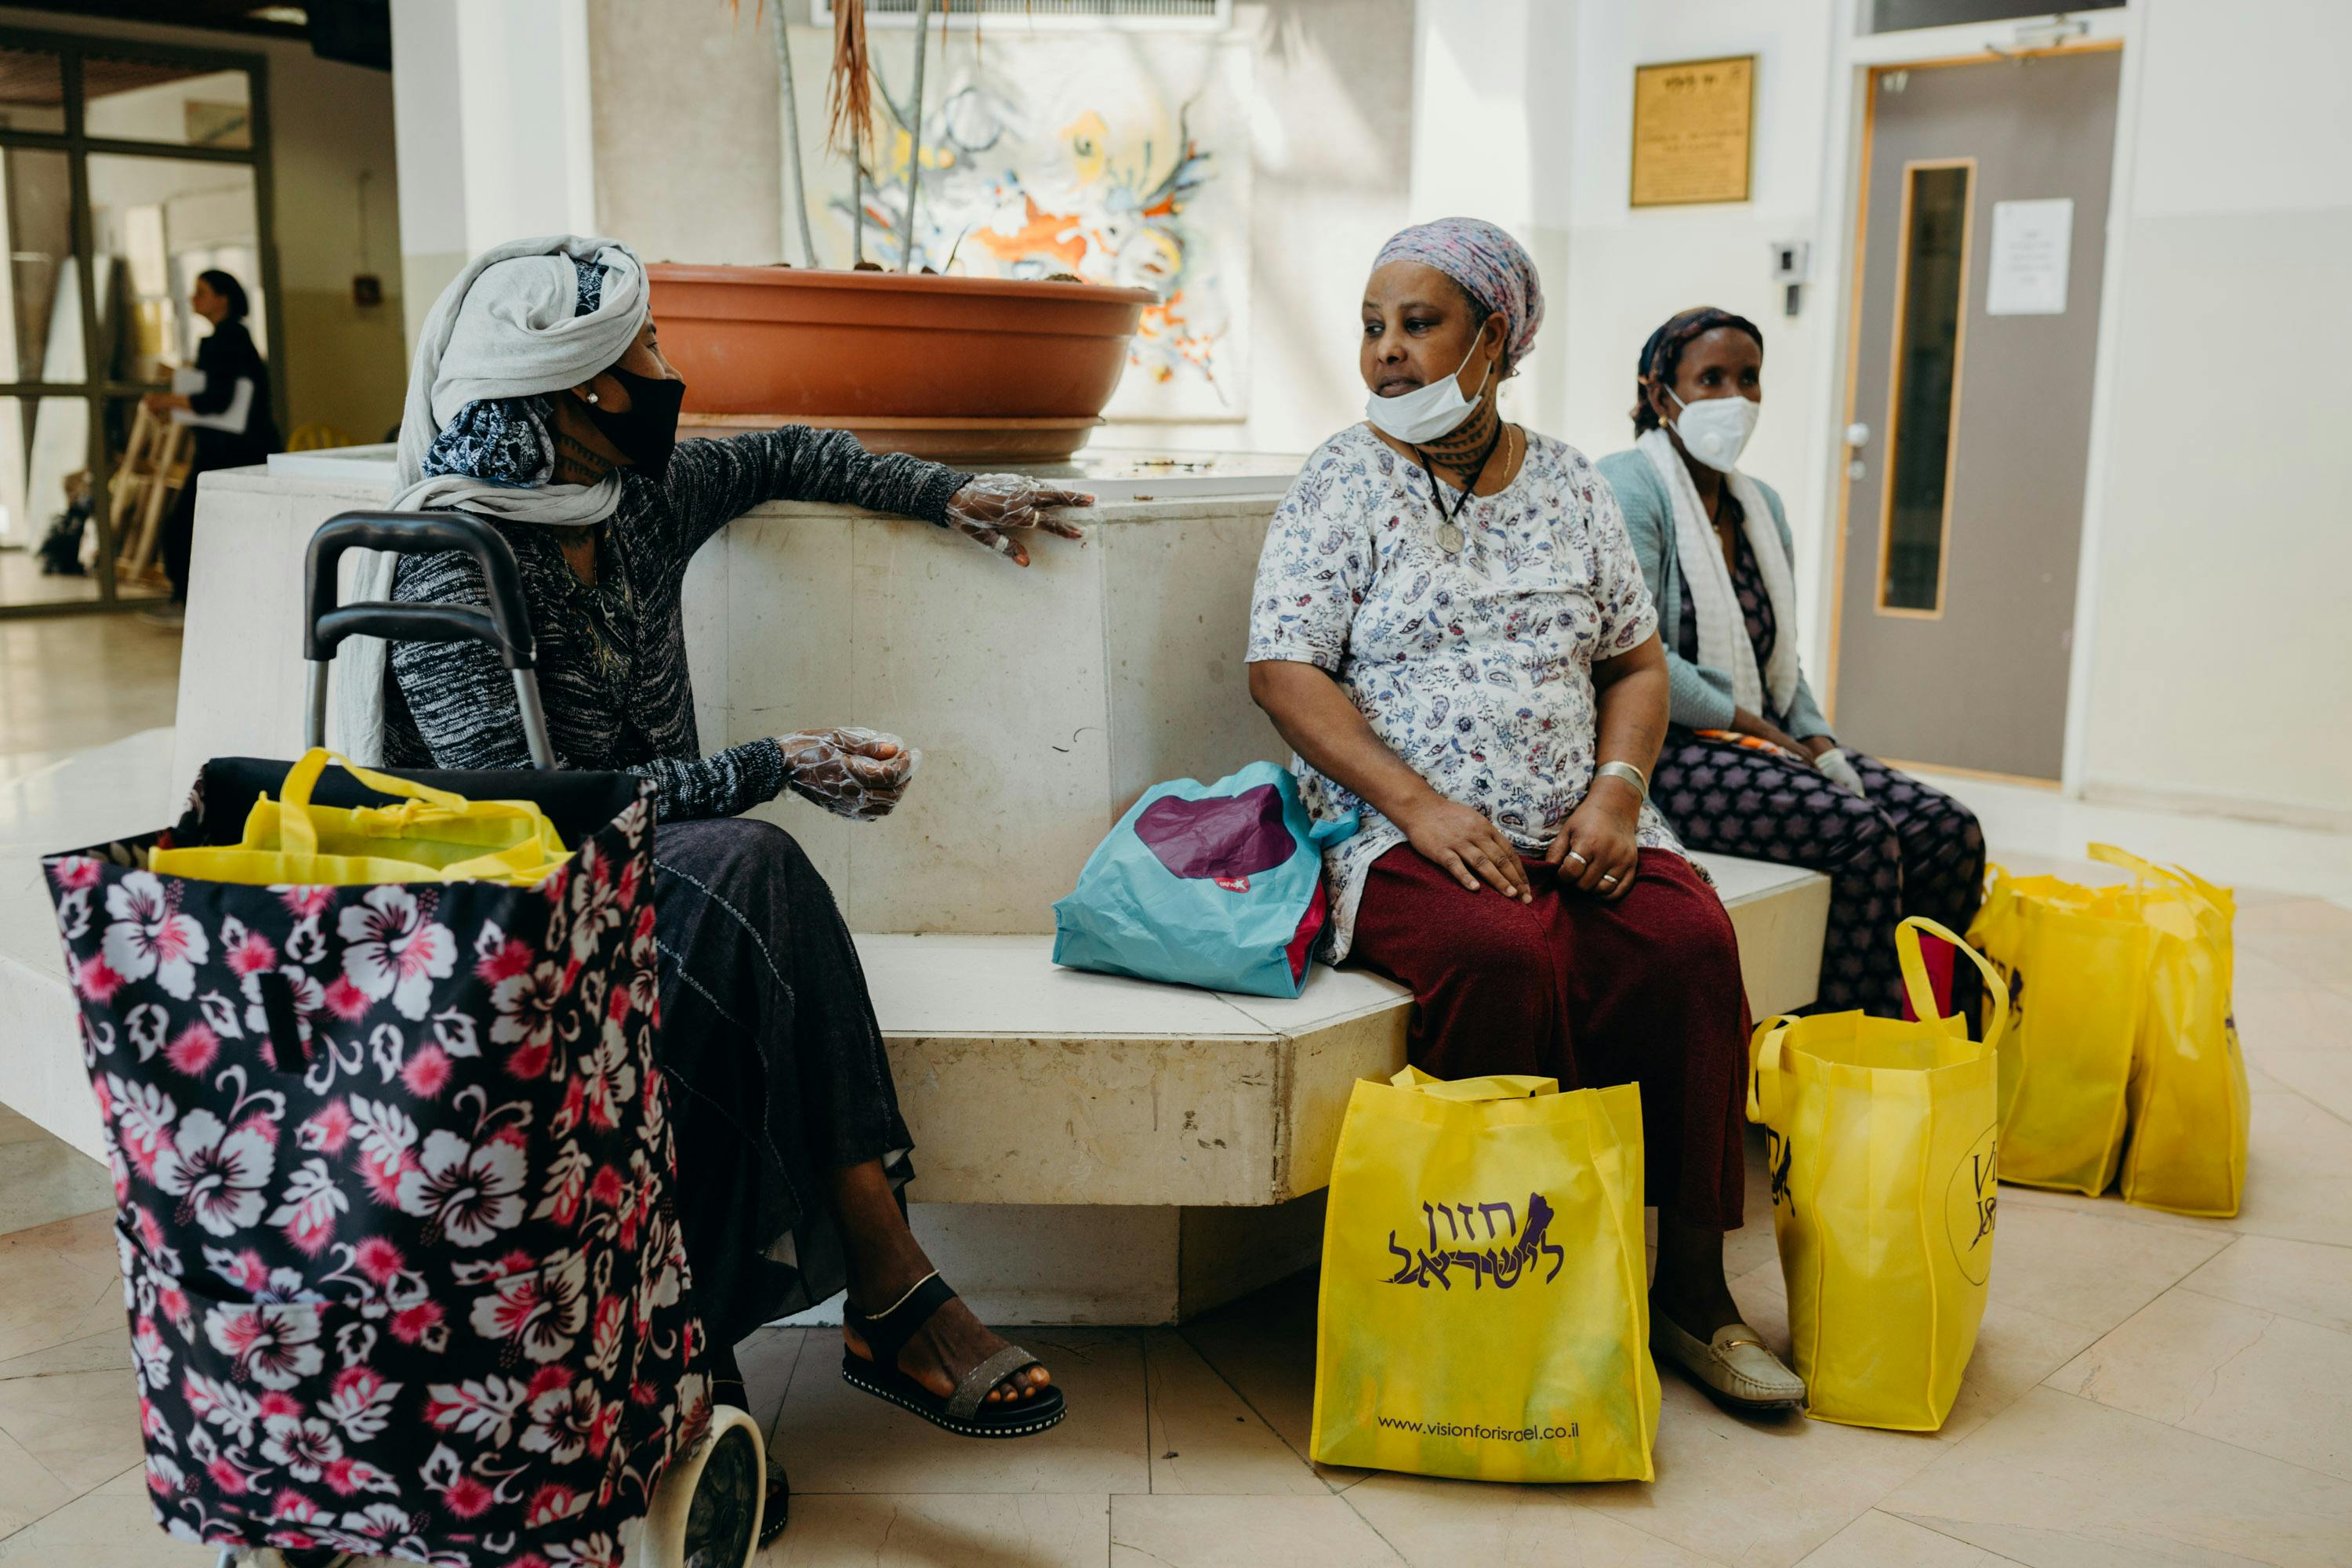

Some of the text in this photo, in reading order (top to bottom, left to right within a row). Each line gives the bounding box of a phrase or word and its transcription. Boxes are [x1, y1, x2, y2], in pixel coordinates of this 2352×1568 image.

[1422, 1200, 1516, 1254] חזון
[1388, 1229, 1565, 1291] לישראל
[1377, 1416, 1580, 1443] www.visionforisrael.co.il
